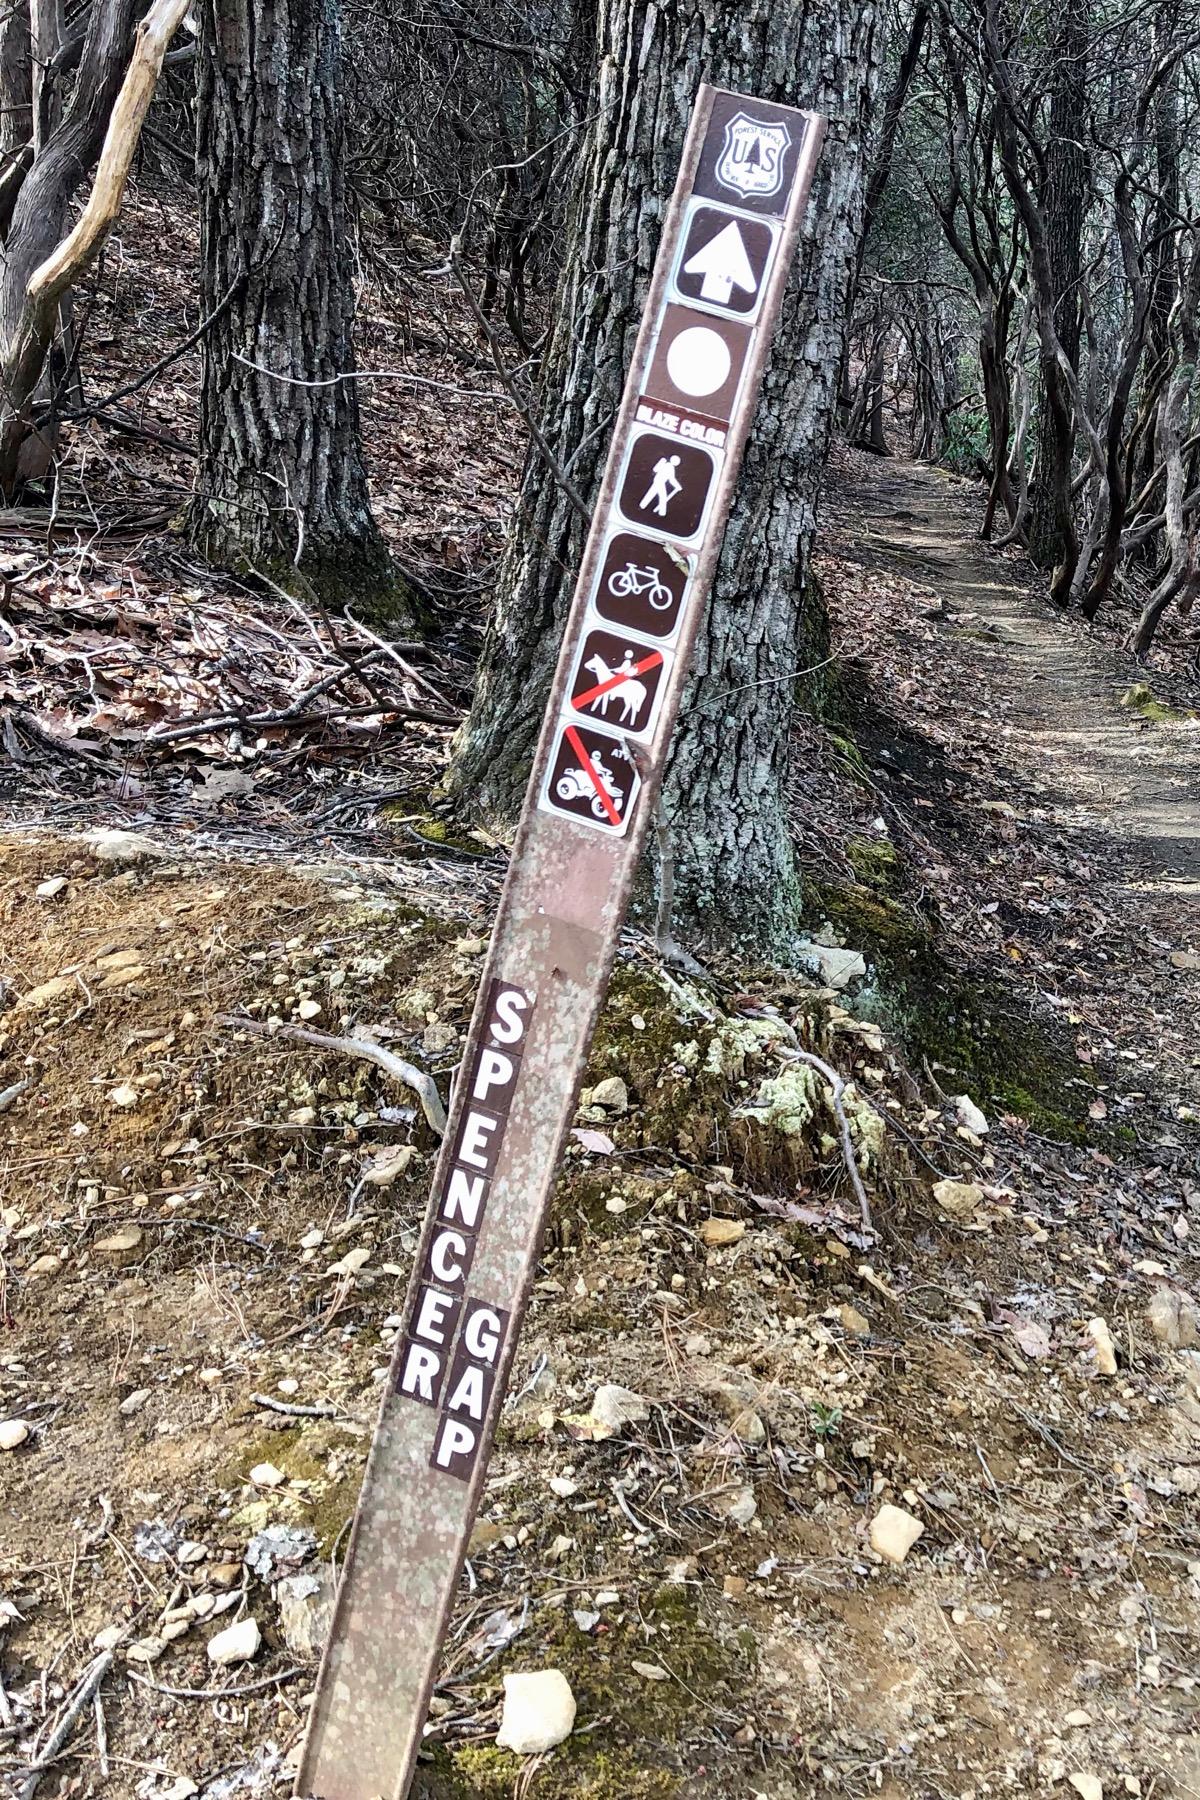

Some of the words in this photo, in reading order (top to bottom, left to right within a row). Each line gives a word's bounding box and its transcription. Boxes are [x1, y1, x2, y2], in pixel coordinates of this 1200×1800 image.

[635, 404, 680, 432] BLAZE
[680, 419, 726, 447] COLOR
[401, 989, 528, 1402] SPENCER
[436, 1308, 500, 1469] GAP
